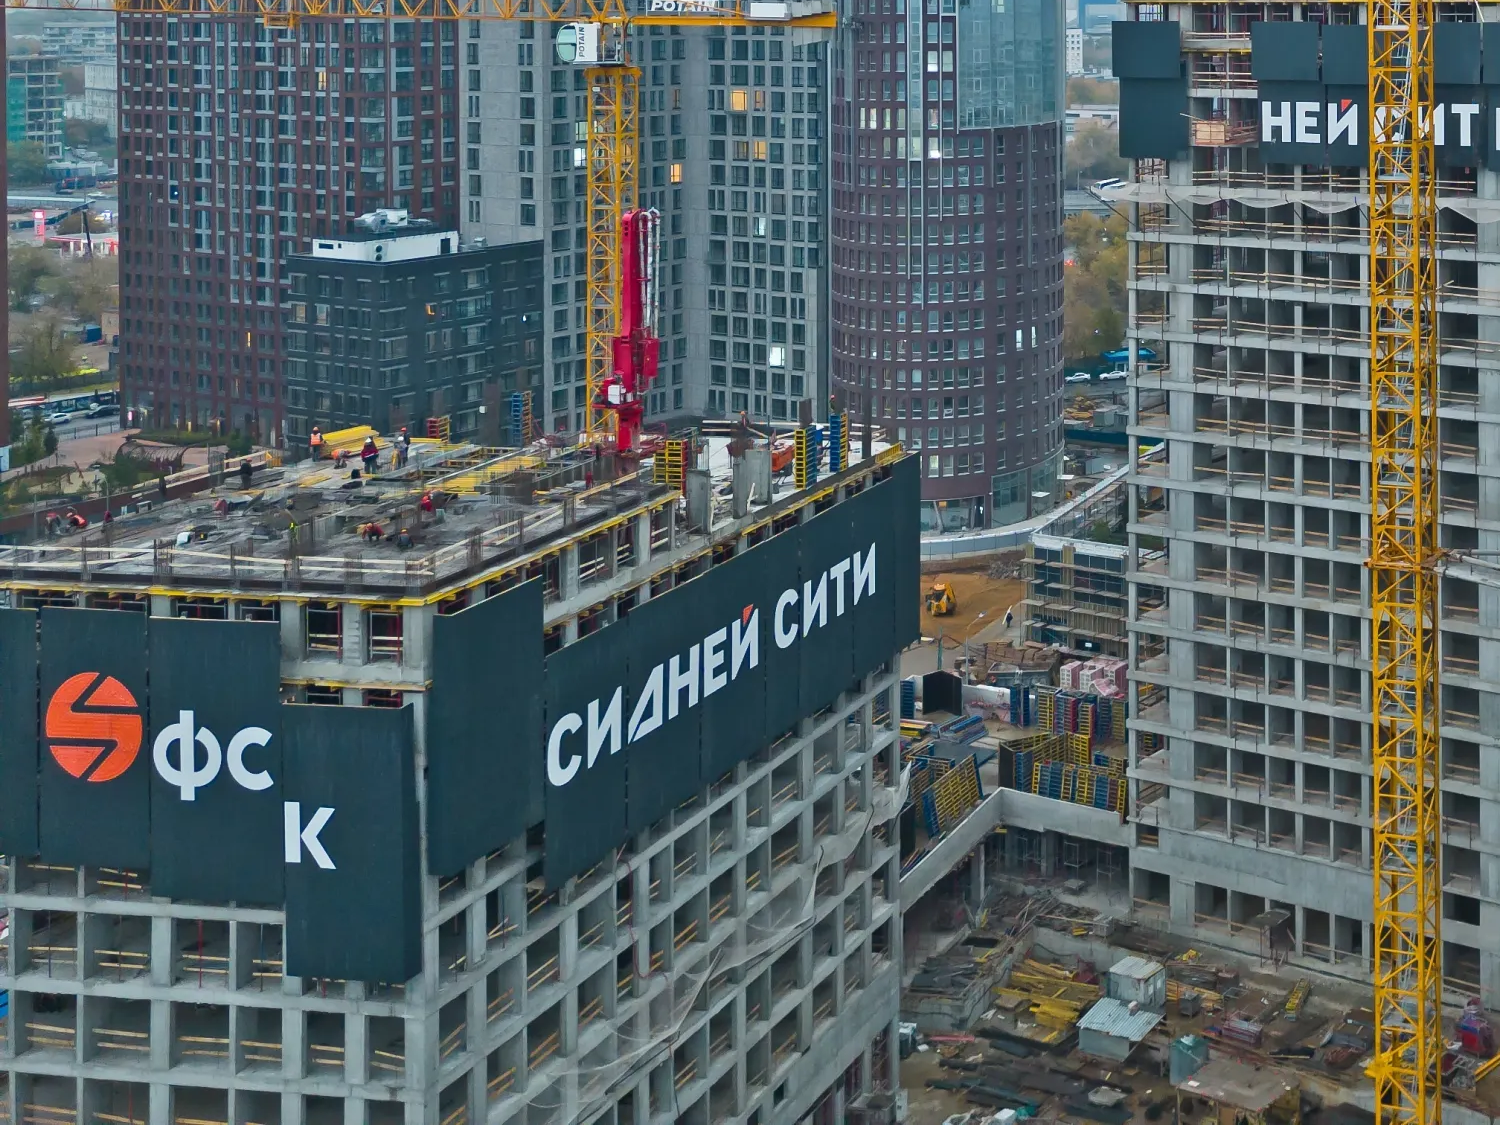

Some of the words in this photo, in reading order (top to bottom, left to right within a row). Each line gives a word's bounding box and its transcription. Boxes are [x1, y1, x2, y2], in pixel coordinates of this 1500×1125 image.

[650, 0, 715, 12] POTAIN
[1261, 98, 1358, 146] НЕЙ
[547, 604, 759, 787] СИДНЕЙ
[774, 542, 876, 649] СИТИ
